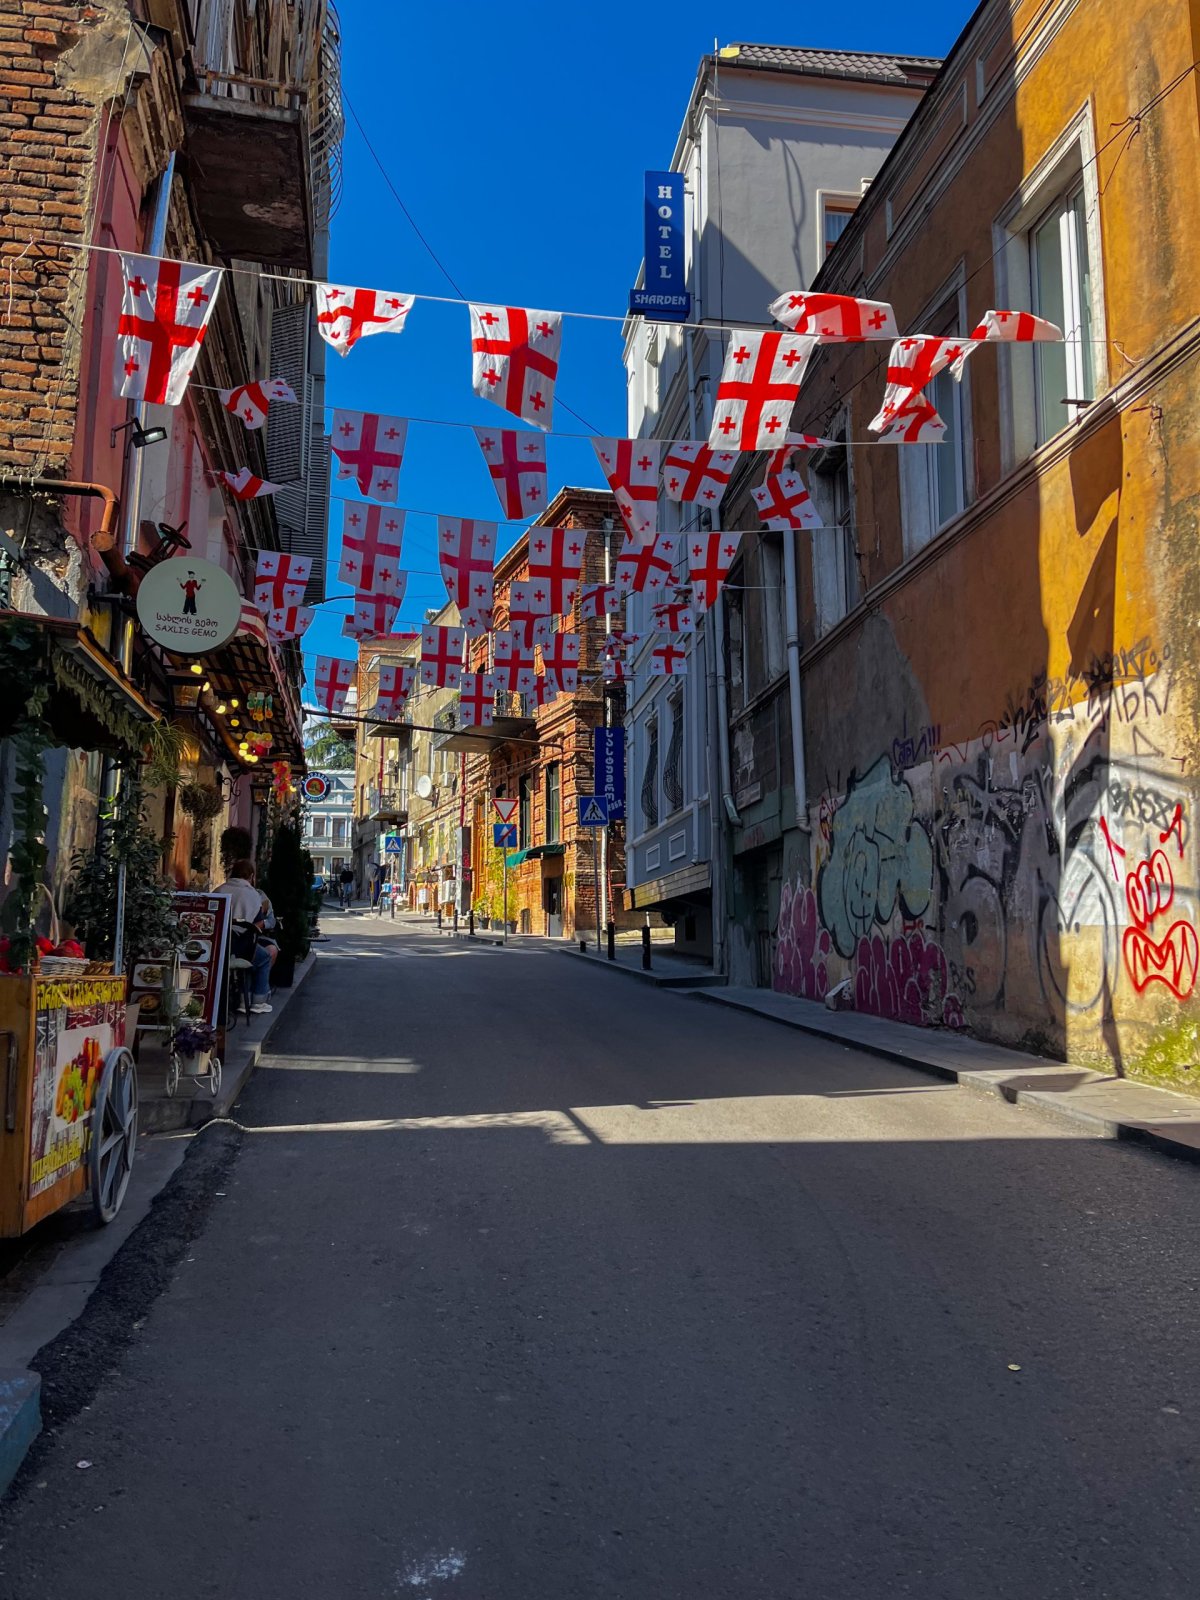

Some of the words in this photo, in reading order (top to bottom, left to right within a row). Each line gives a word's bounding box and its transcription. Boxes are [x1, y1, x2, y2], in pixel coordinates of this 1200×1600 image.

[657, 185, 673, 279] HOTEL
[634, 294, 687, 306] SHARDEN
[156, 612, 192, 624] სახლის
[195, 618, 218, 628] გემო
[155, 624, 189, 634] SAXLIS
[191, 628, 218, 638] GEMO
